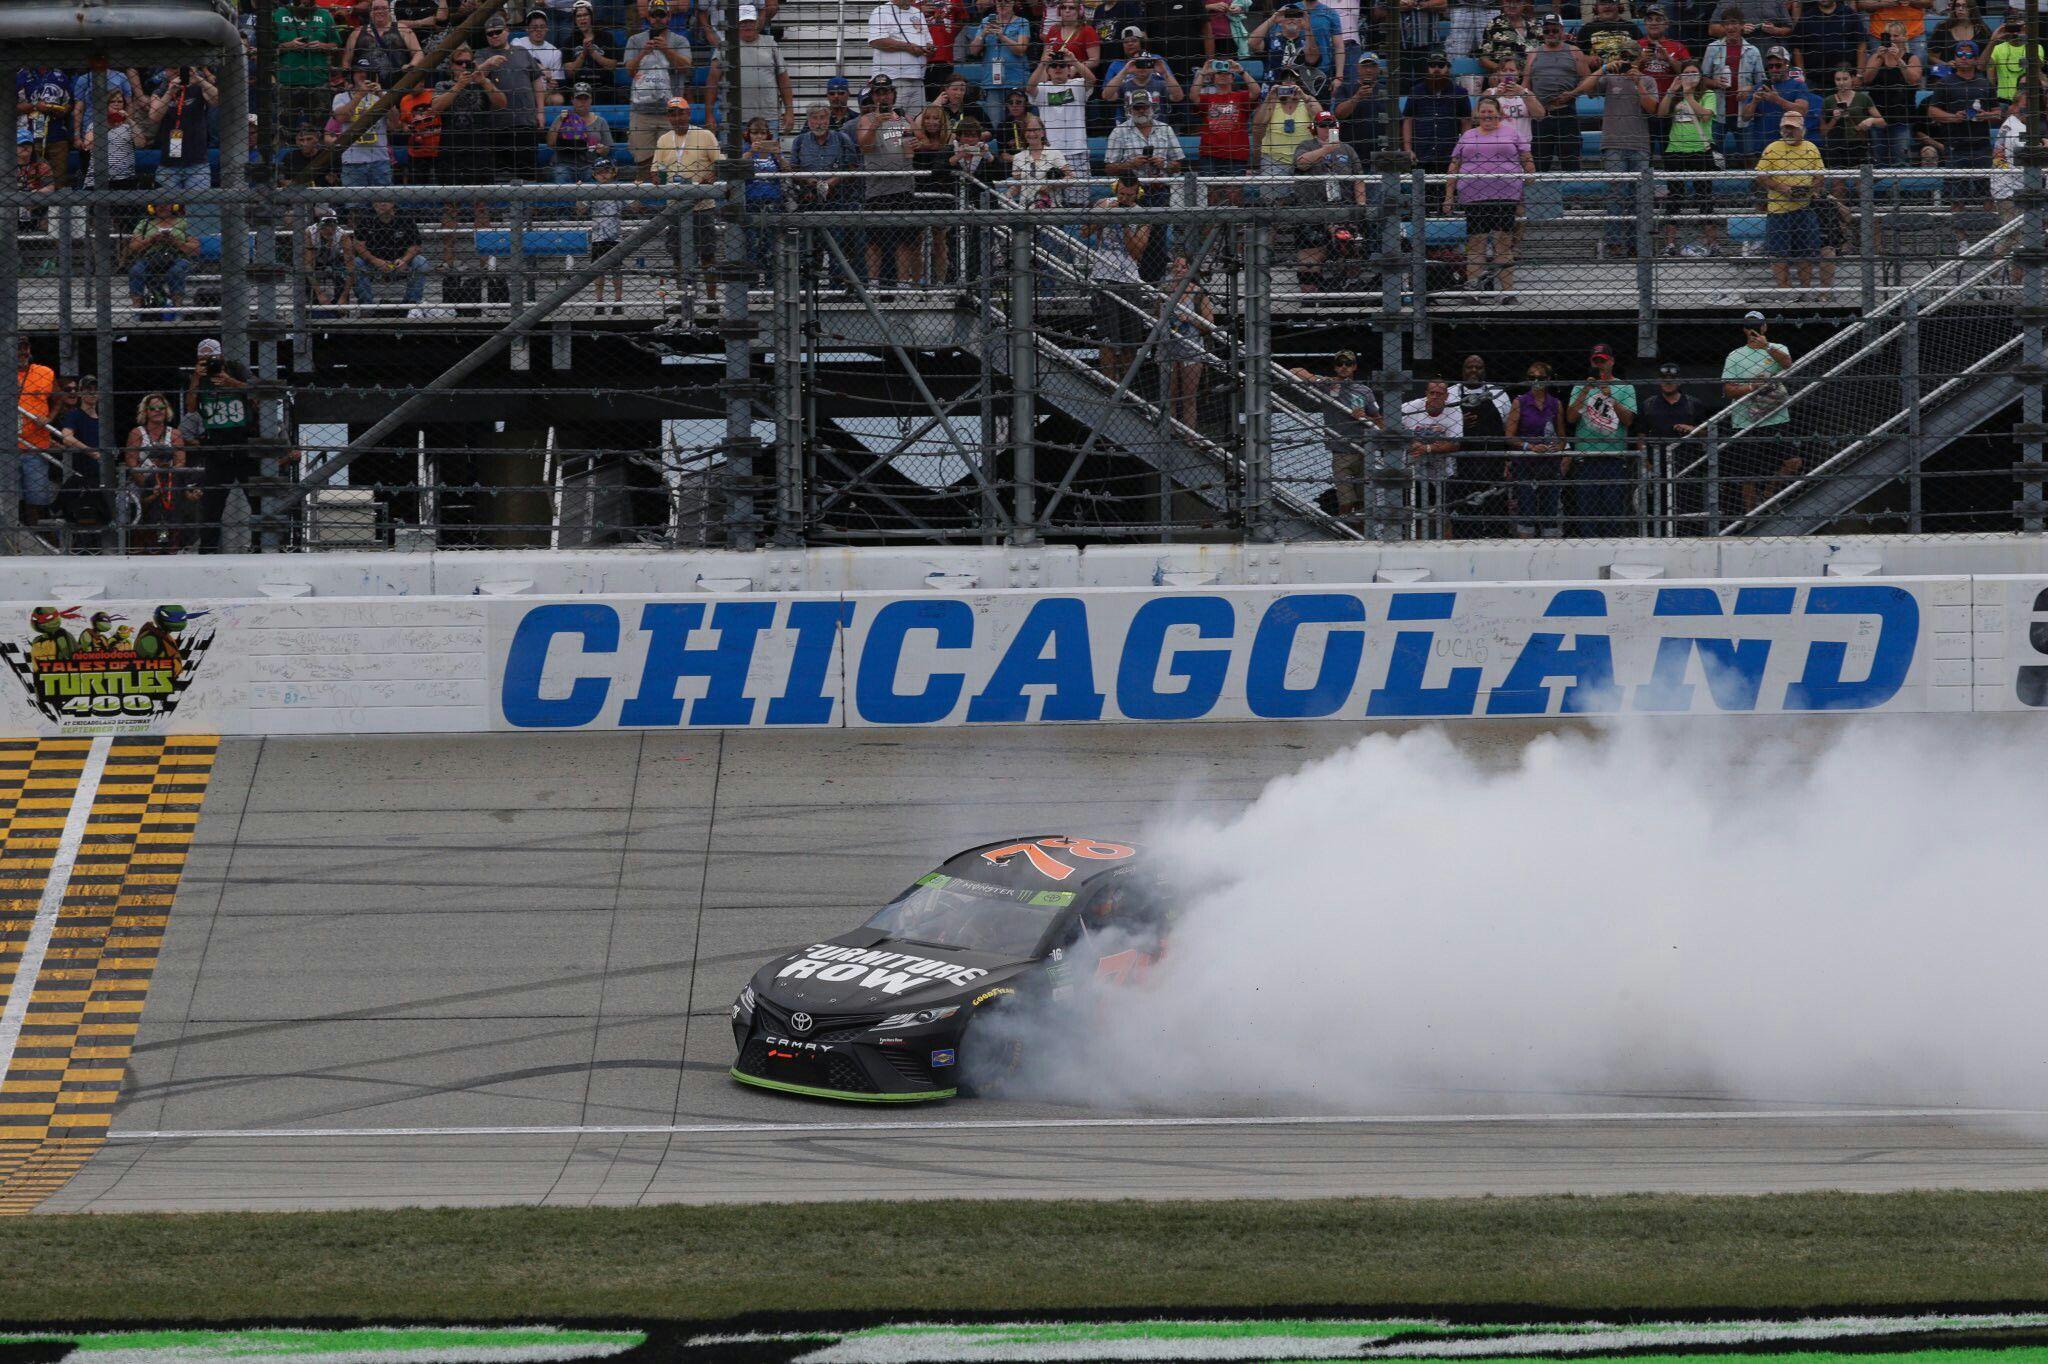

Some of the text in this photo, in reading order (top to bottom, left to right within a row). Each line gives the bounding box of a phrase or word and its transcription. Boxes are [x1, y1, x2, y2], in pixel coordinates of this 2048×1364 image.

[72, 650, 137, 659] nickelodeon
[502, 585, 1920, 727] CHICAGOLAND
[39, 660, 173, 673] TALES OF THE
[39, 670, 173, 697] TURTLES
[62, 694, 153, 714] 400
[980, 838, 1136, 881] 78
[963, 881, 1015, 896] MONSTER
[804, 943, 989, 987] FURNITURE
[776, 958, 932, 995] ROW
[972, 986, 1016, 1006] GOODYEAR
[766, 1036, 834, 1053] CAMRY
